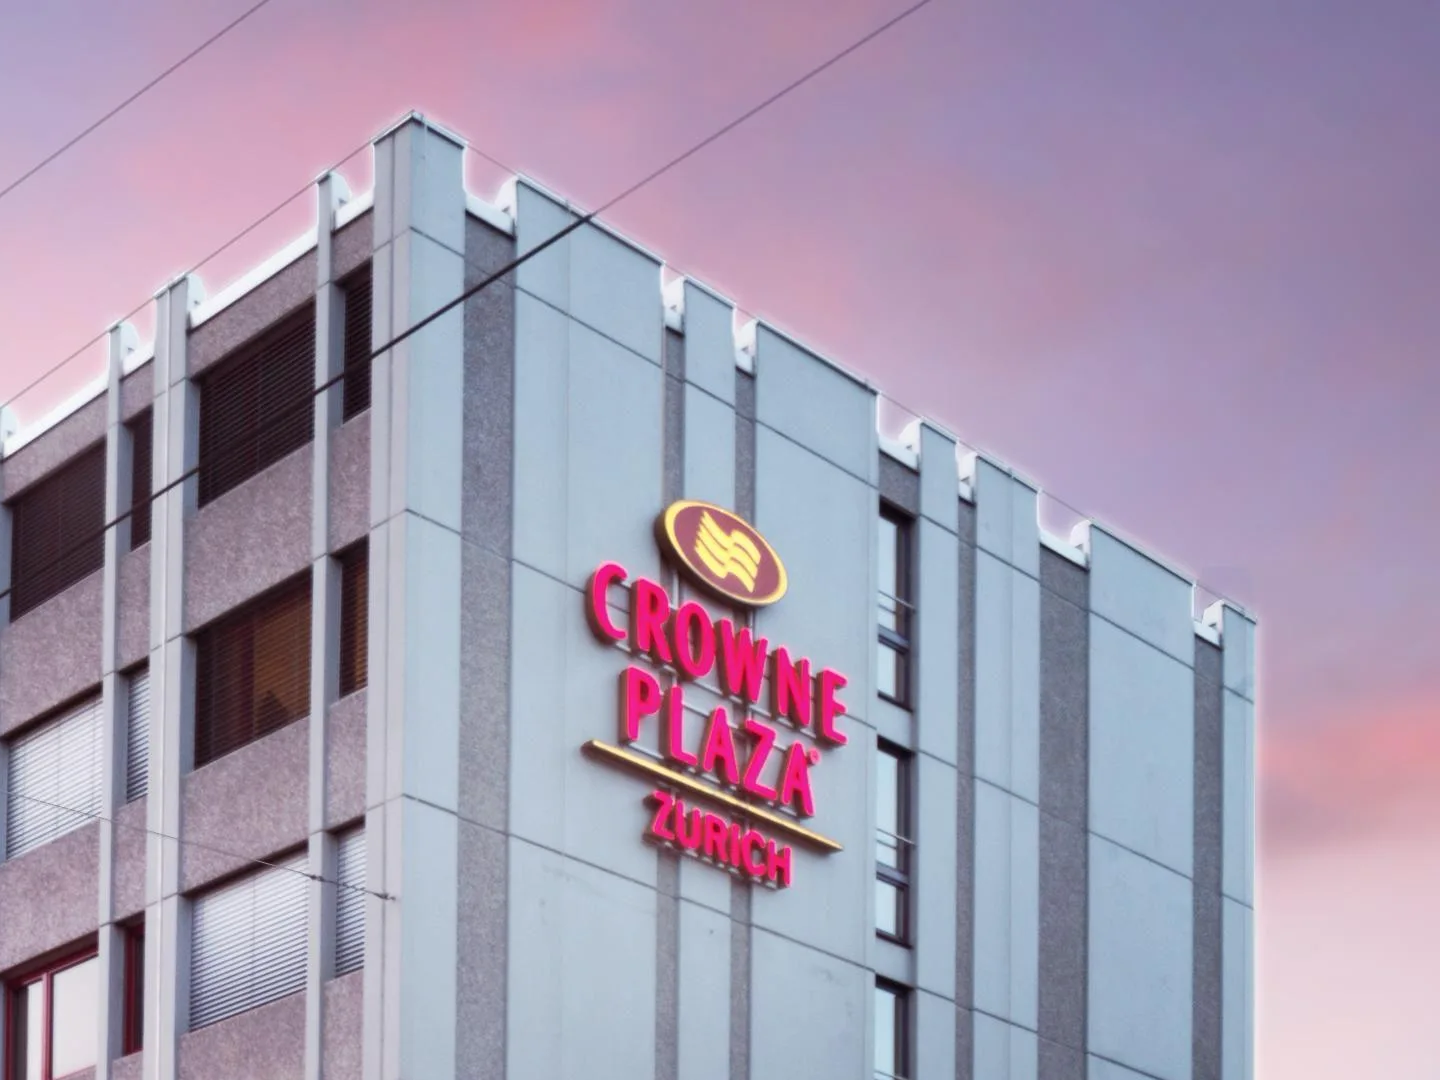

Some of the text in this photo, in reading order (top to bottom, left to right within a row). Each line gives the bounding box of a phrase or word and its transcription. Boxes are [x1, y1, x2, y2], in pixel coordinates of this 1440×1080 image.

[590, 561, 848, 745] CROWNE
[622, 665, 816, 818] PLAZA
[652, 790, 793, 887] ZURICH
